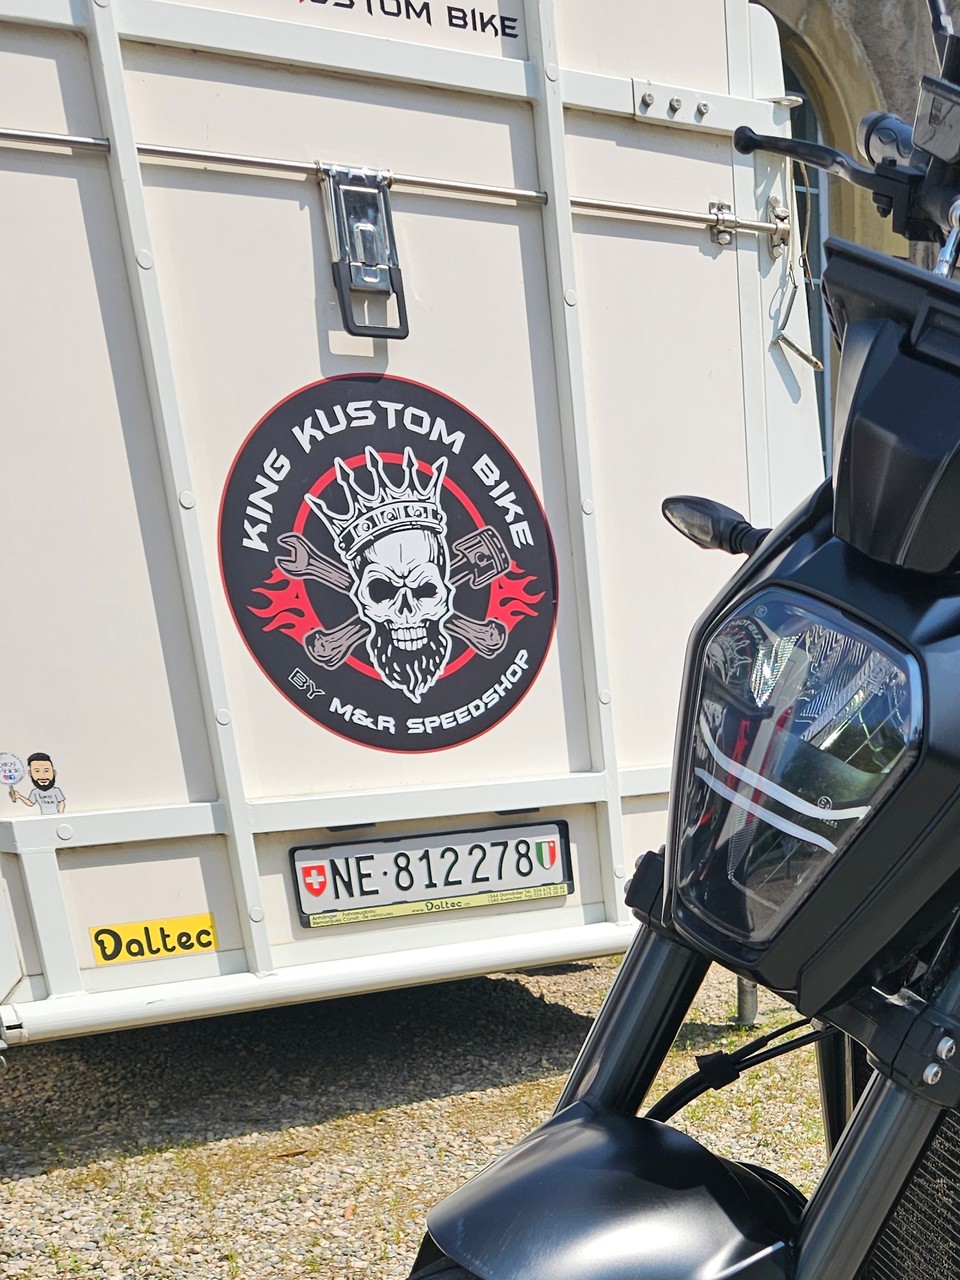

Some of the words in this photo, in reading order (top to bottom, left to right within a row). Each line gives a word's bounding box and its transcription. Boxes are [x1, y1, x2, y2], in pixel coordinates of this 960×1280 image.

[446, 5, 520, 39] BIKE
[242, 447, 292, 552] KING
[291, 399, 467, 455] KUSTOM
[471, 453, 535, 549] BIKE
[287, 667, 326, 700] BY
[328, 696, 396, 735] M&R
[405, 648, 531, 735] SPEEDSHOP
[94, 926, 213, 962] Daltec
